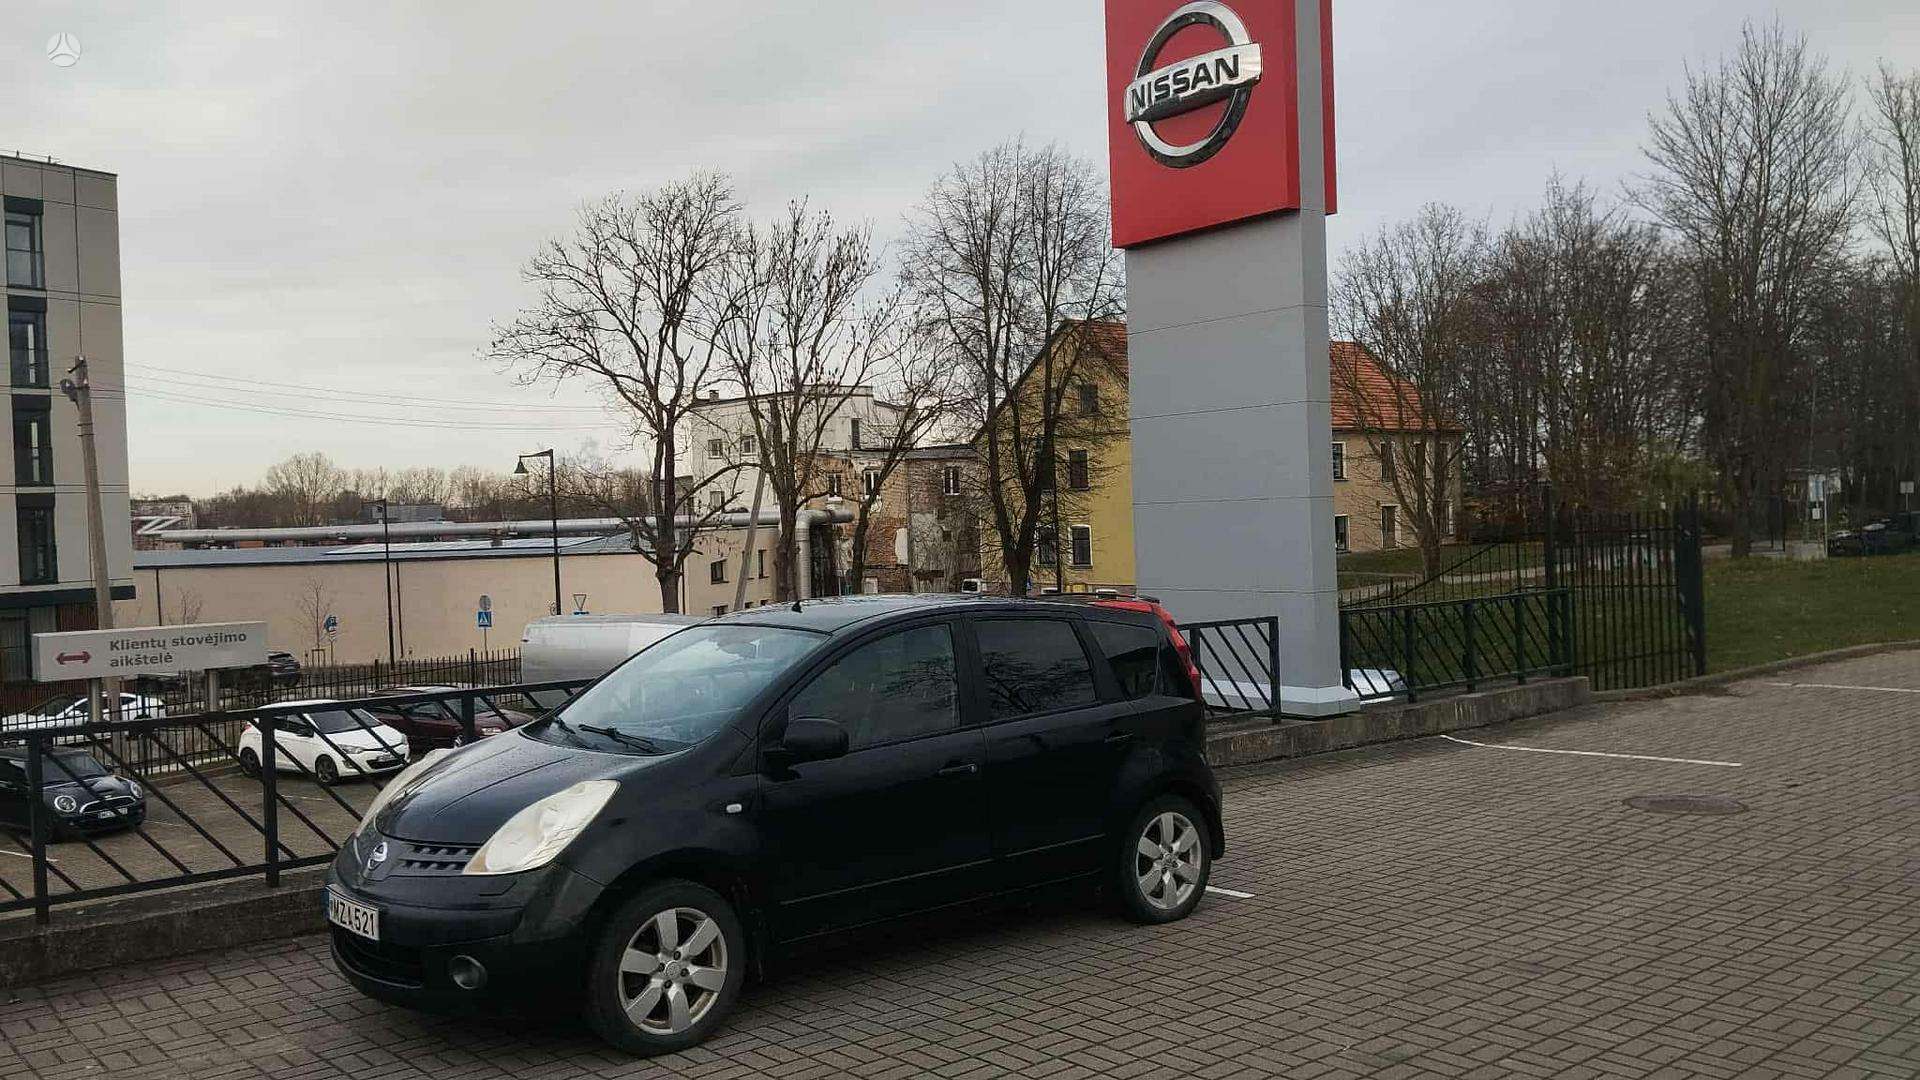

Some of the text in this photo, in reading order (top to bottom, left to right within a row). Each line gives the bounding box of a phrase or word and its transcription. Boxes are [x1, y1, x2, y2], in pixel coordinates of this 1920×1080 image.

[1131, 54, 1239, 111] NISSAN
[109, 632, 247, 651] Klientų stovėjimo
[110, 652, 173, 668] aikštelė
